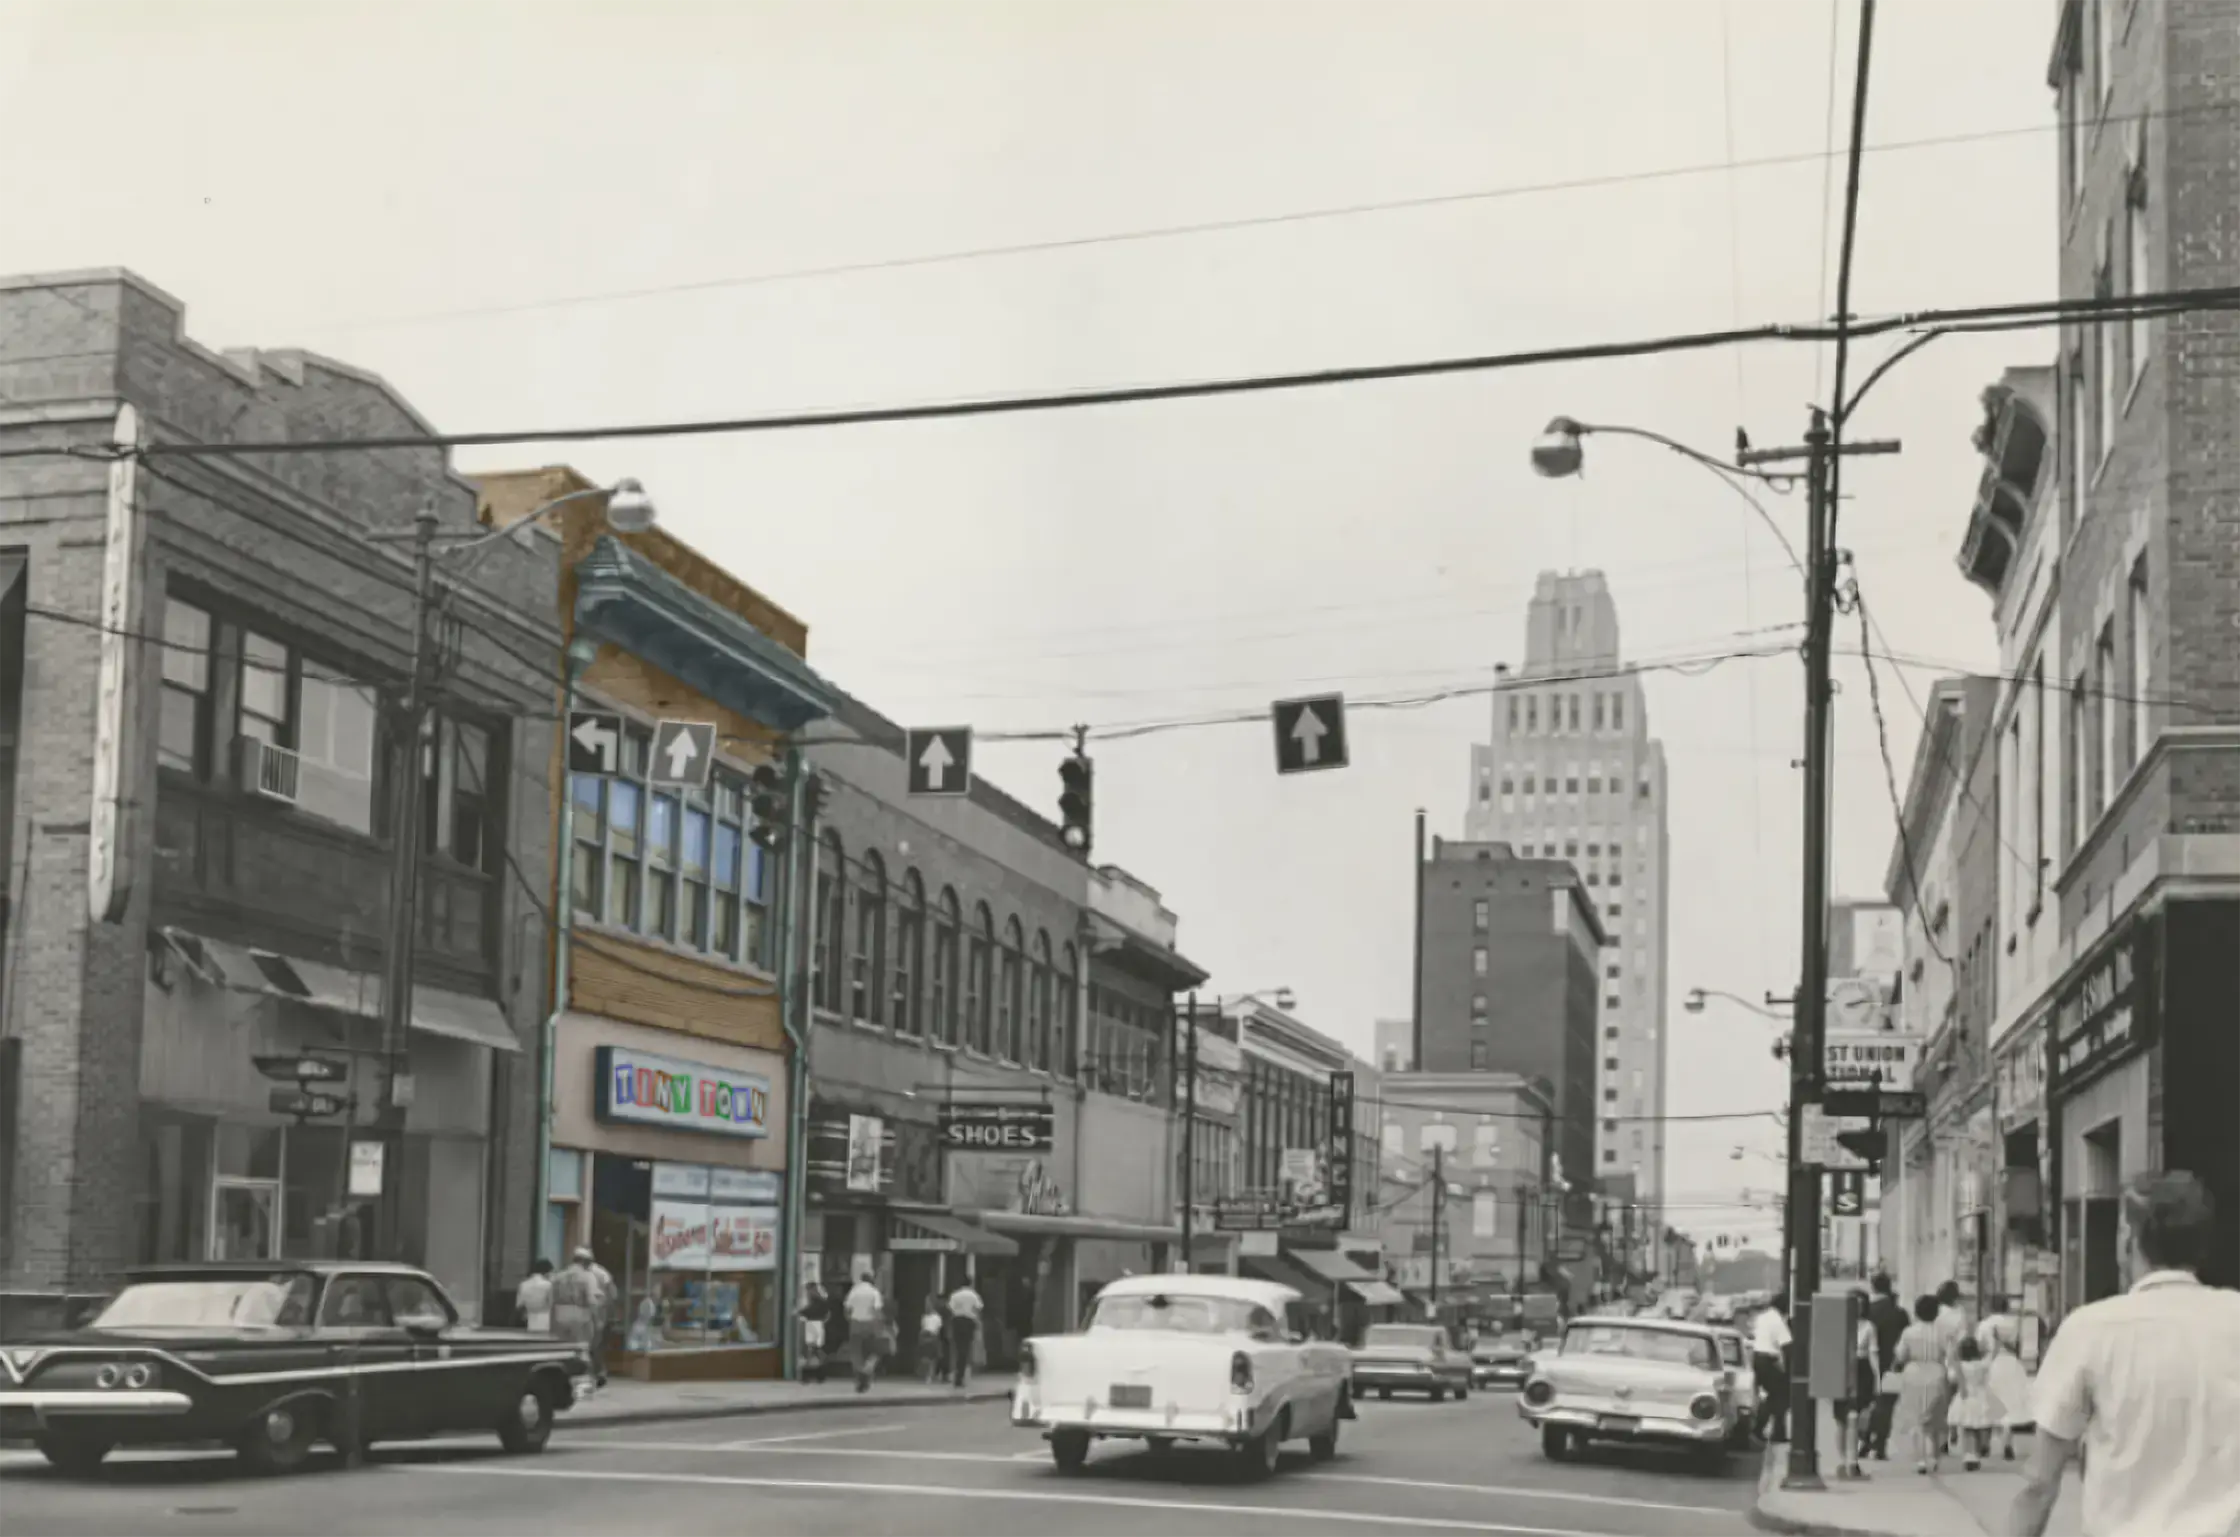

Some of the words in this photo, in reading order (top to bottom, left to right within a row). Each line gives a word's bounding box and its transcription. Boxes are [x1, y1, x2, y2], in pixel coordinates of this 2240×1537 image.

[1854, 1046, 1905, 1062] UNION
[615, 1064, 691, 1113] TINY
[948, 1124, 1036, 1145] SHOES
